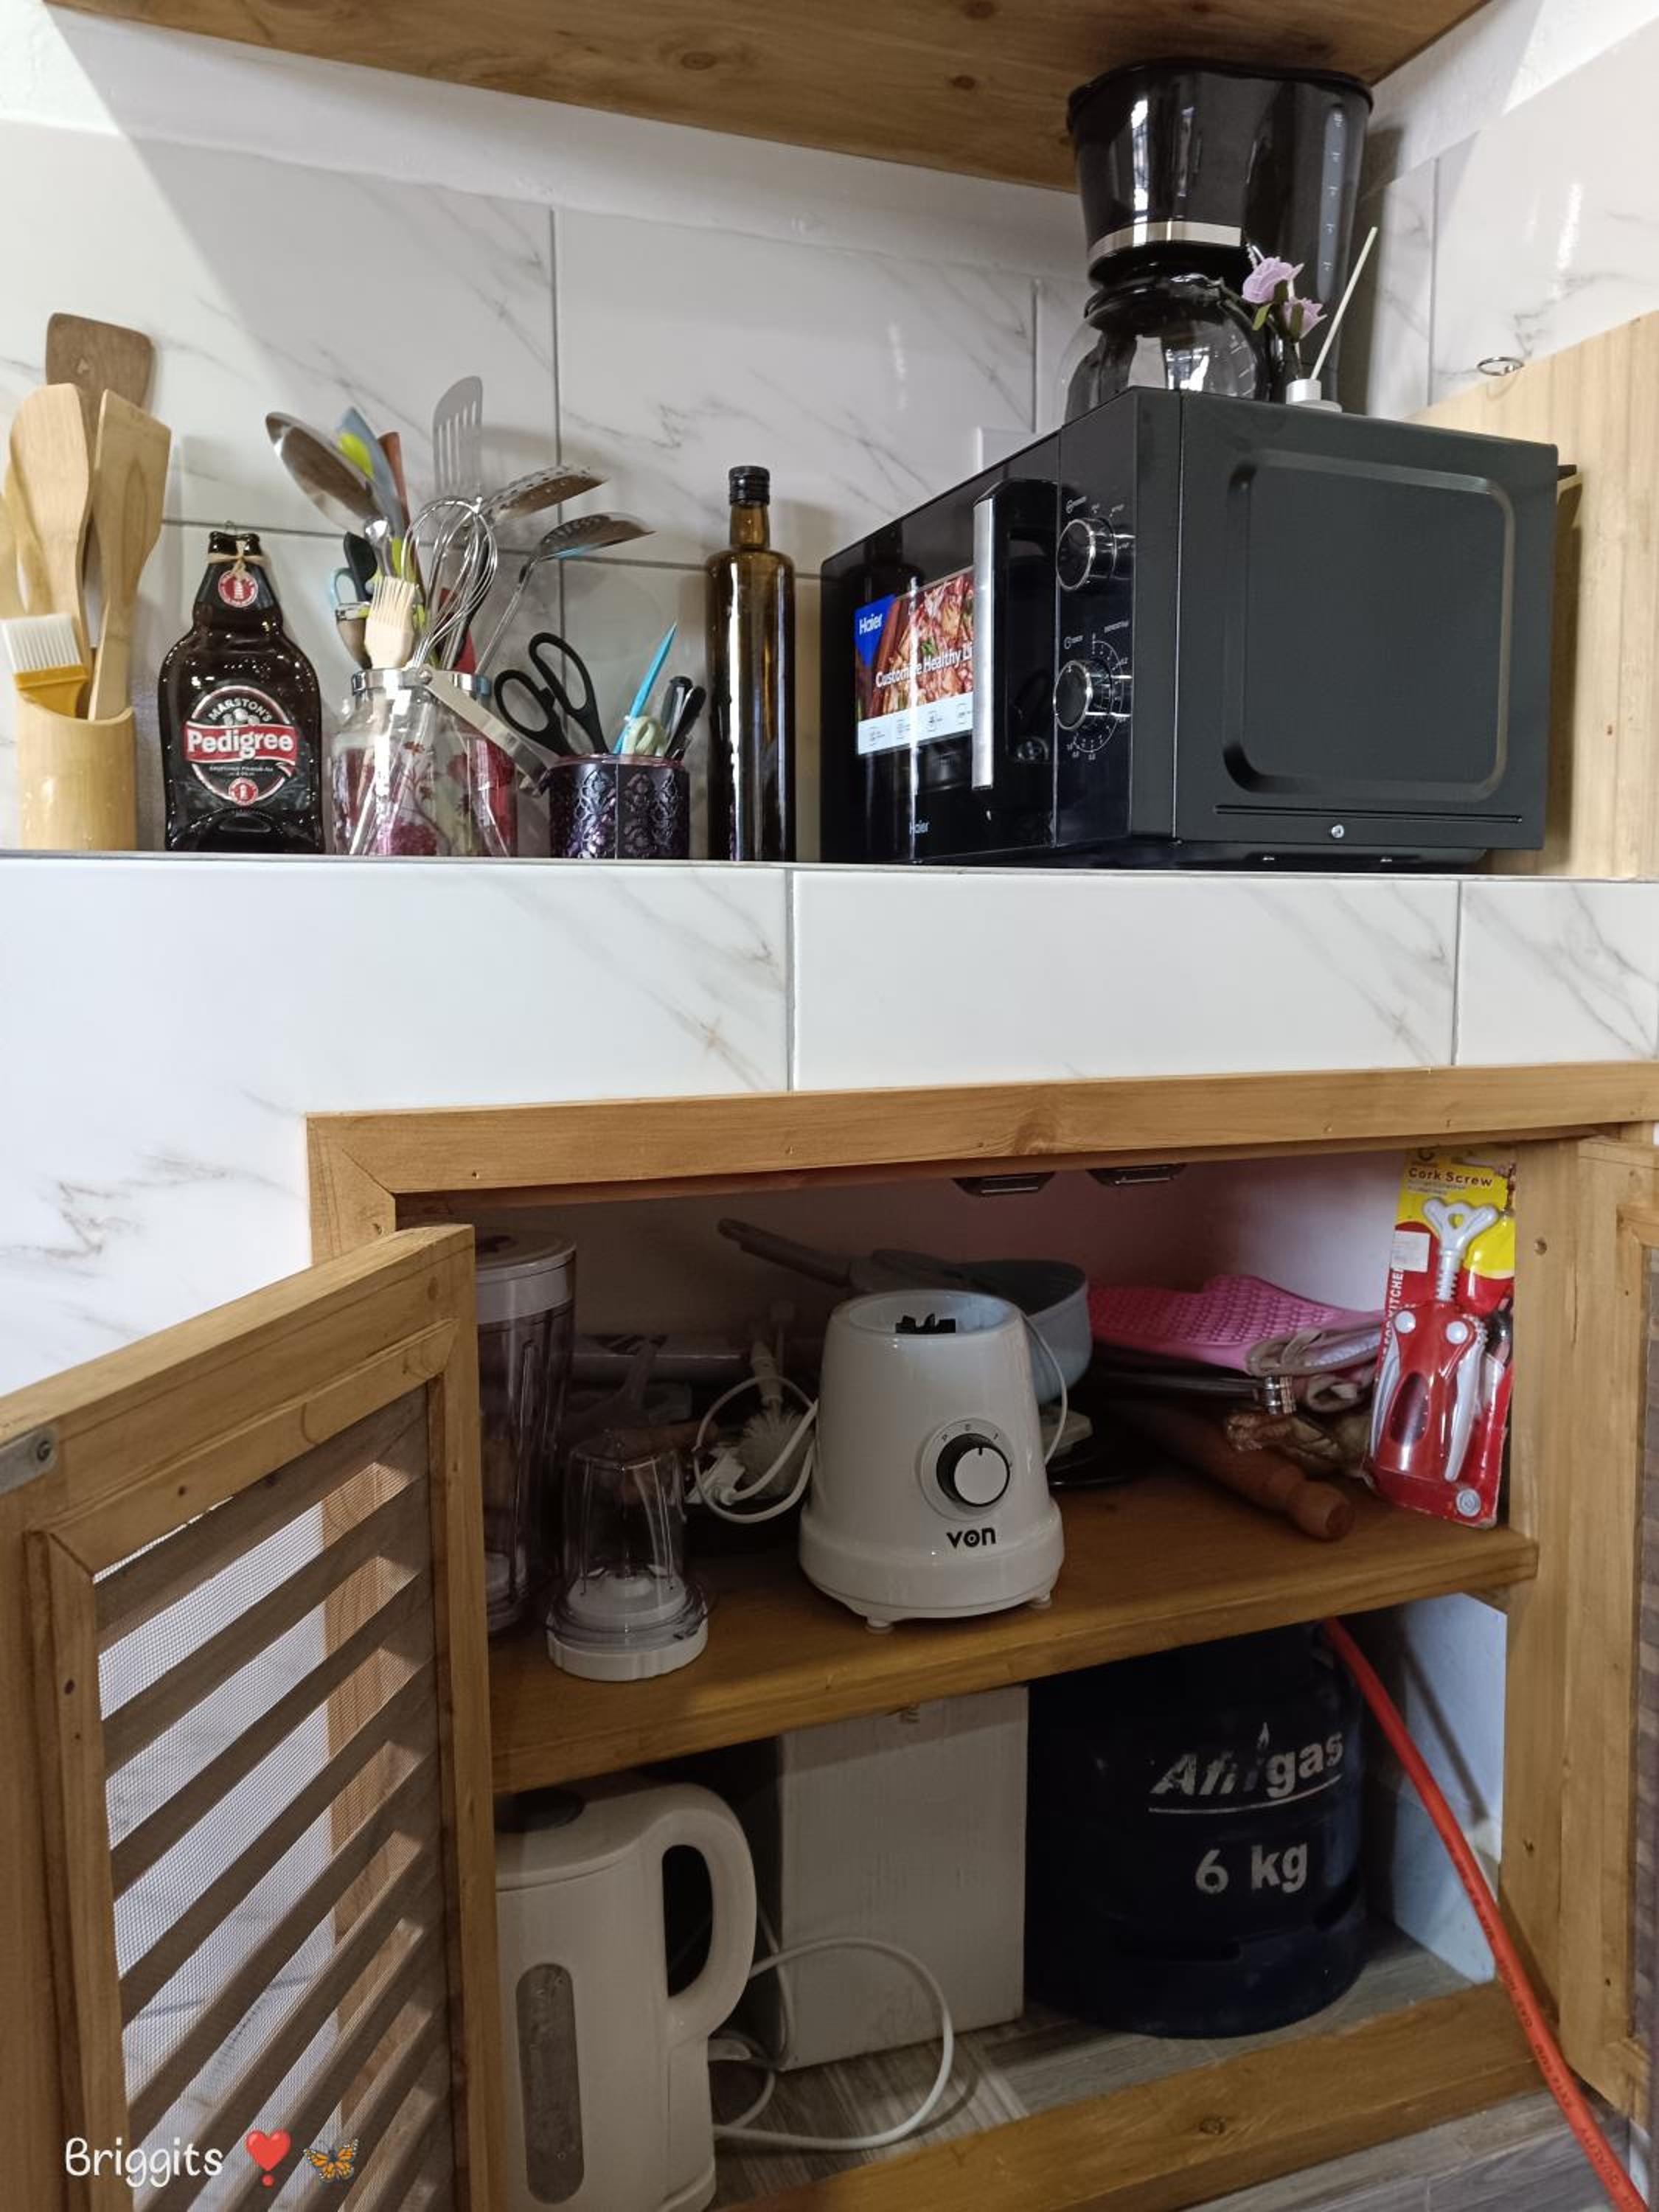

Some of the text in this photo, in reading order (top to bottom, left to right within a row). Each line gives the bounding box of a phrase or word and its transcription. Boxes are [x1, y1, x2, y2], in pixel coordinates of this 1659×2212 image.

[859, 613, 883, 635] Haier
[876, 664, 922, 688] Custome
[923, 647, 961, 673] Healthy
[208, 698, 273, 722] MARSTON'S
[187, 729, 294, 760] Pedigree
[1408, 1167, 1441, 1180] Cork
[1444, 1171, 1493, 1187] Screw
[1388, 1268, 1404, 1318] ITCHE
[946, 1527, 996, 1549] von
[1194, 1842, 1307, 1893] 6 kg
